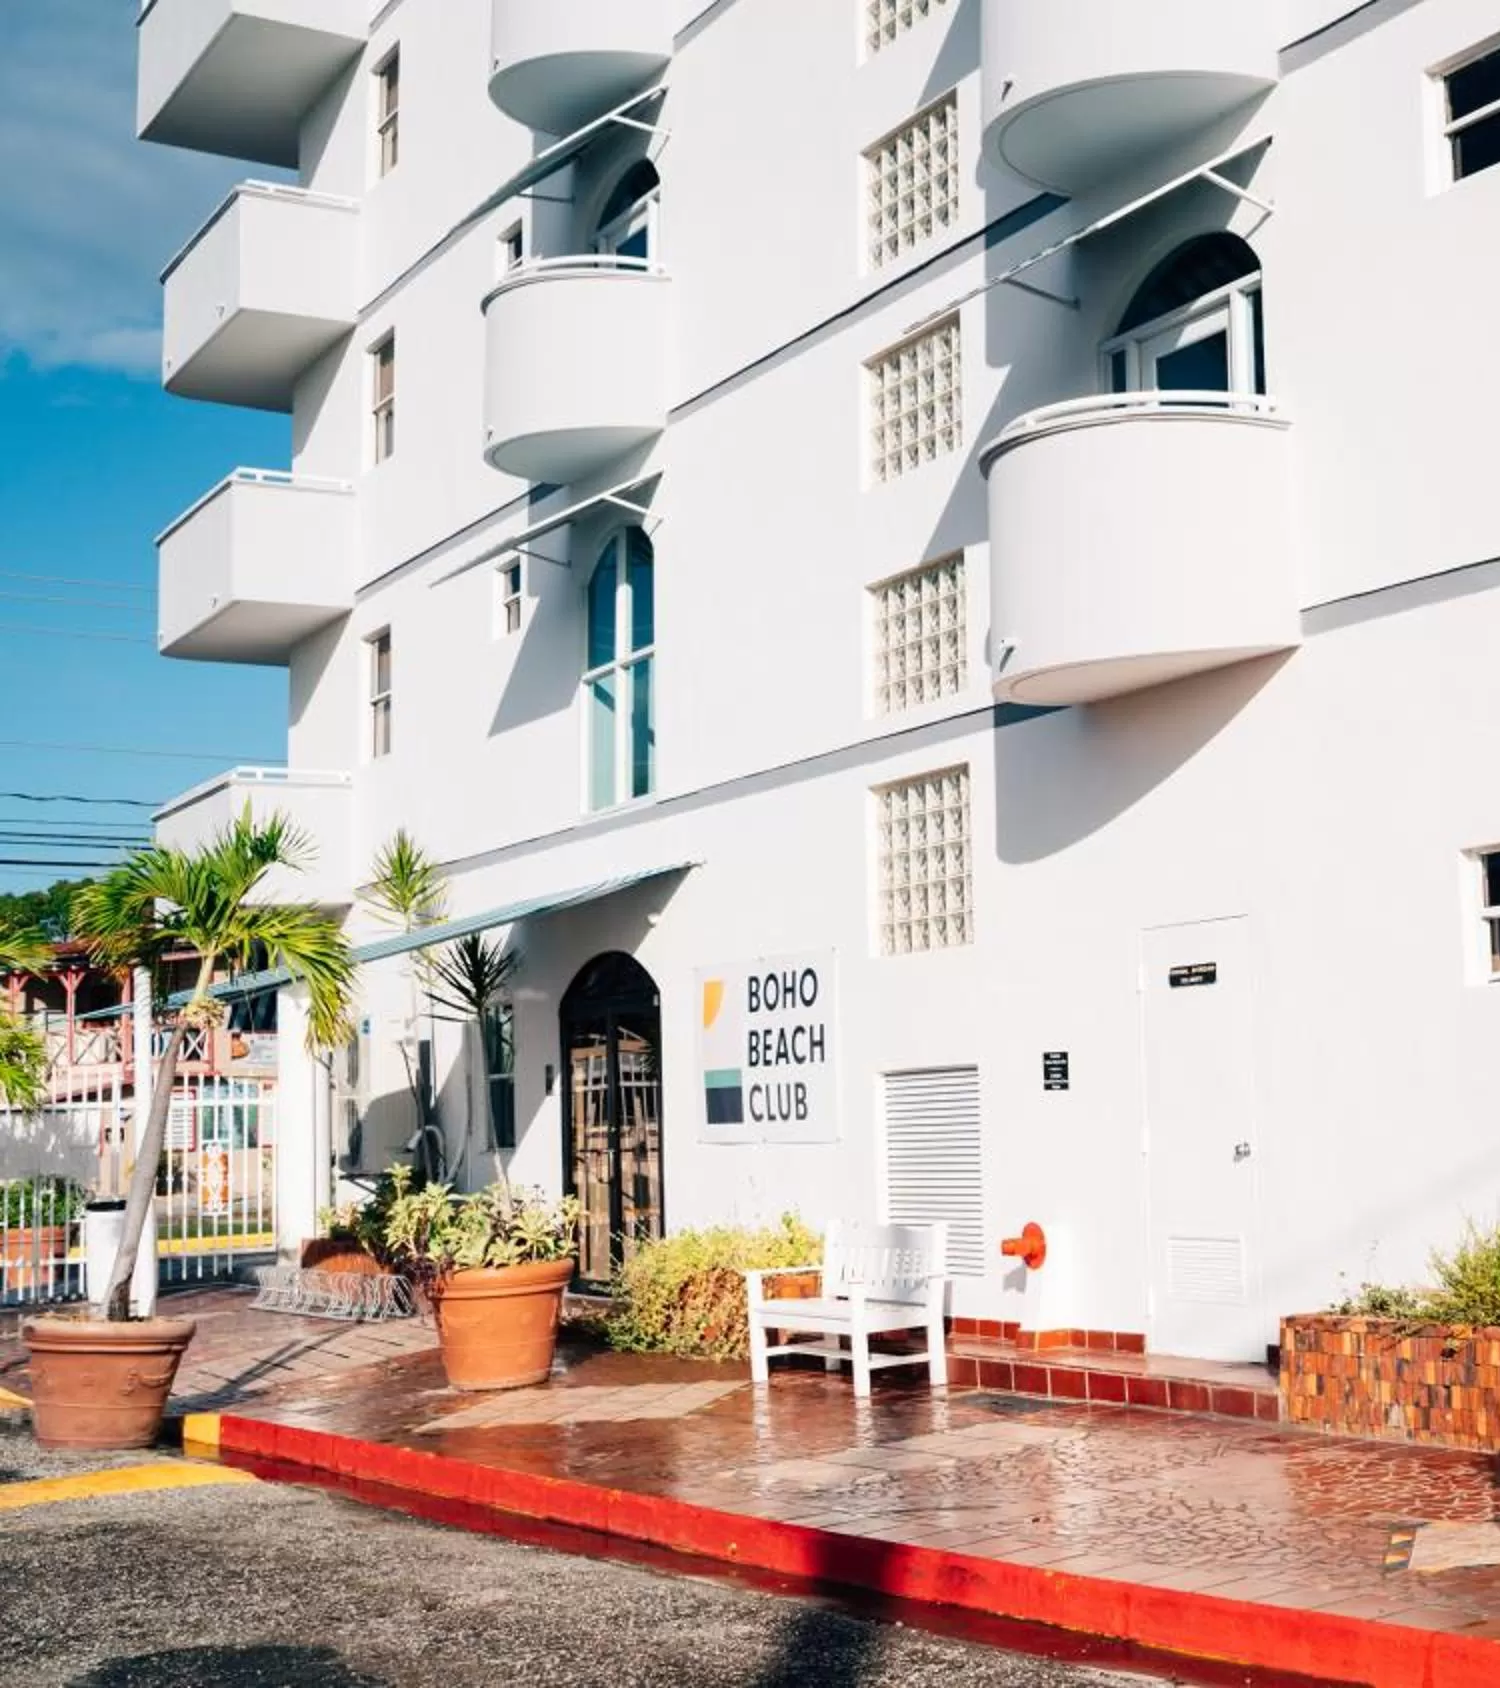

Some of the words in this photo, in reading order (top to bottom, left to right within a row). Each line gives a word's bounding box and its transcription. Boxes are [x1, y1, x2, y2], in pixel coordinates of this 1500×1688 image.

[748, 968, 818, 1012] BOHO
[748, 1024, 825, 1067] BEACH
[749, 1082, 808, 1121] CLUB
